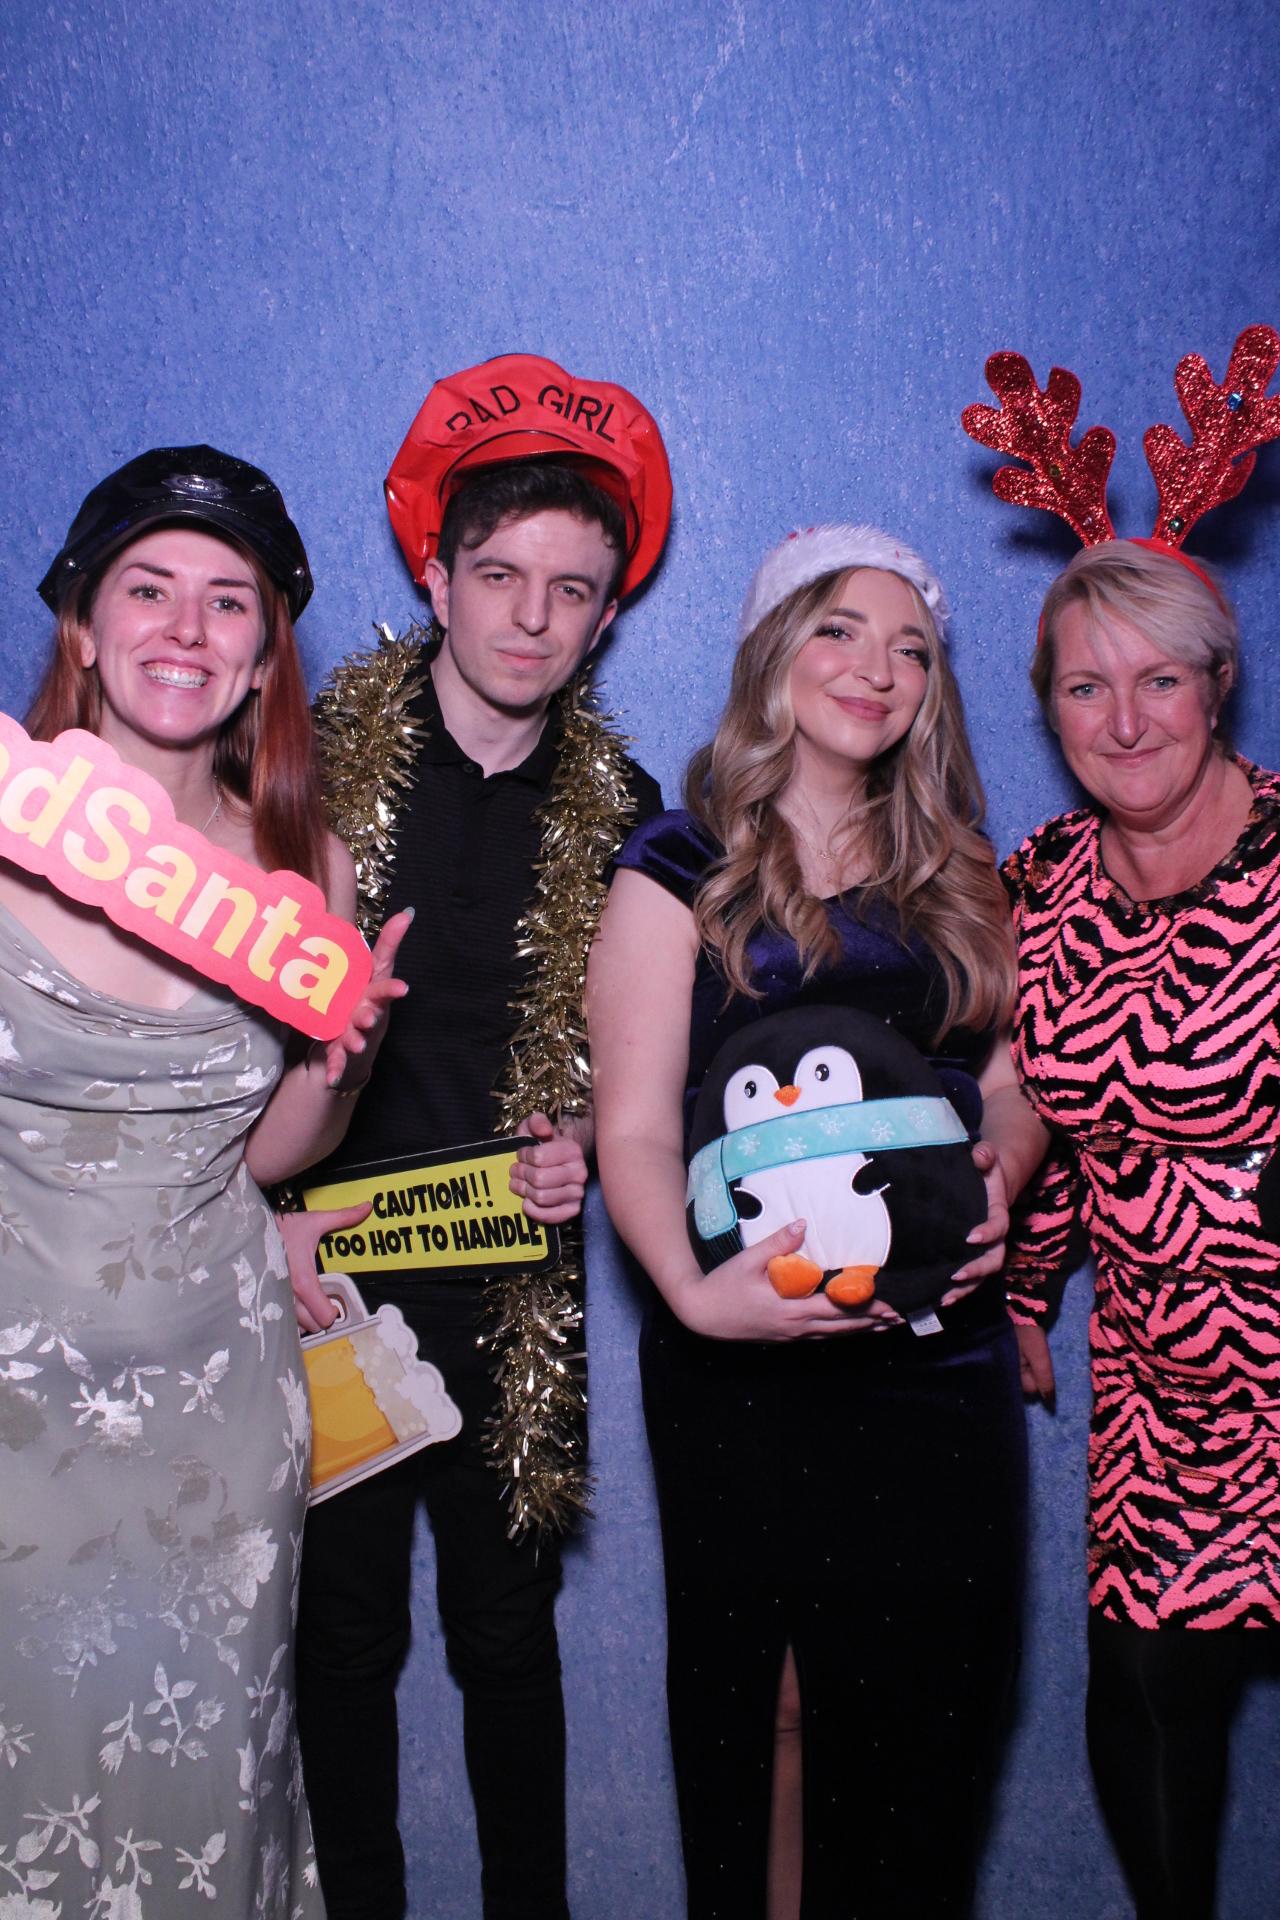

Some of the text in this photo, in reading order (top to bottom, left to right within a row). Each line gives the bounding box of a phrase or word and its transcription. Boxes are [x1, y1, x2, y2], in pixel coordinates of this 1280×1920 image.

[537, 384, 615, 444] GIRL
[0, 743, 349, 1016] dSanta
[372, 1170, 494, 1219] CAUTION!!
[320, 1212, 543, 1259] TOO HOT TO HANDLE
